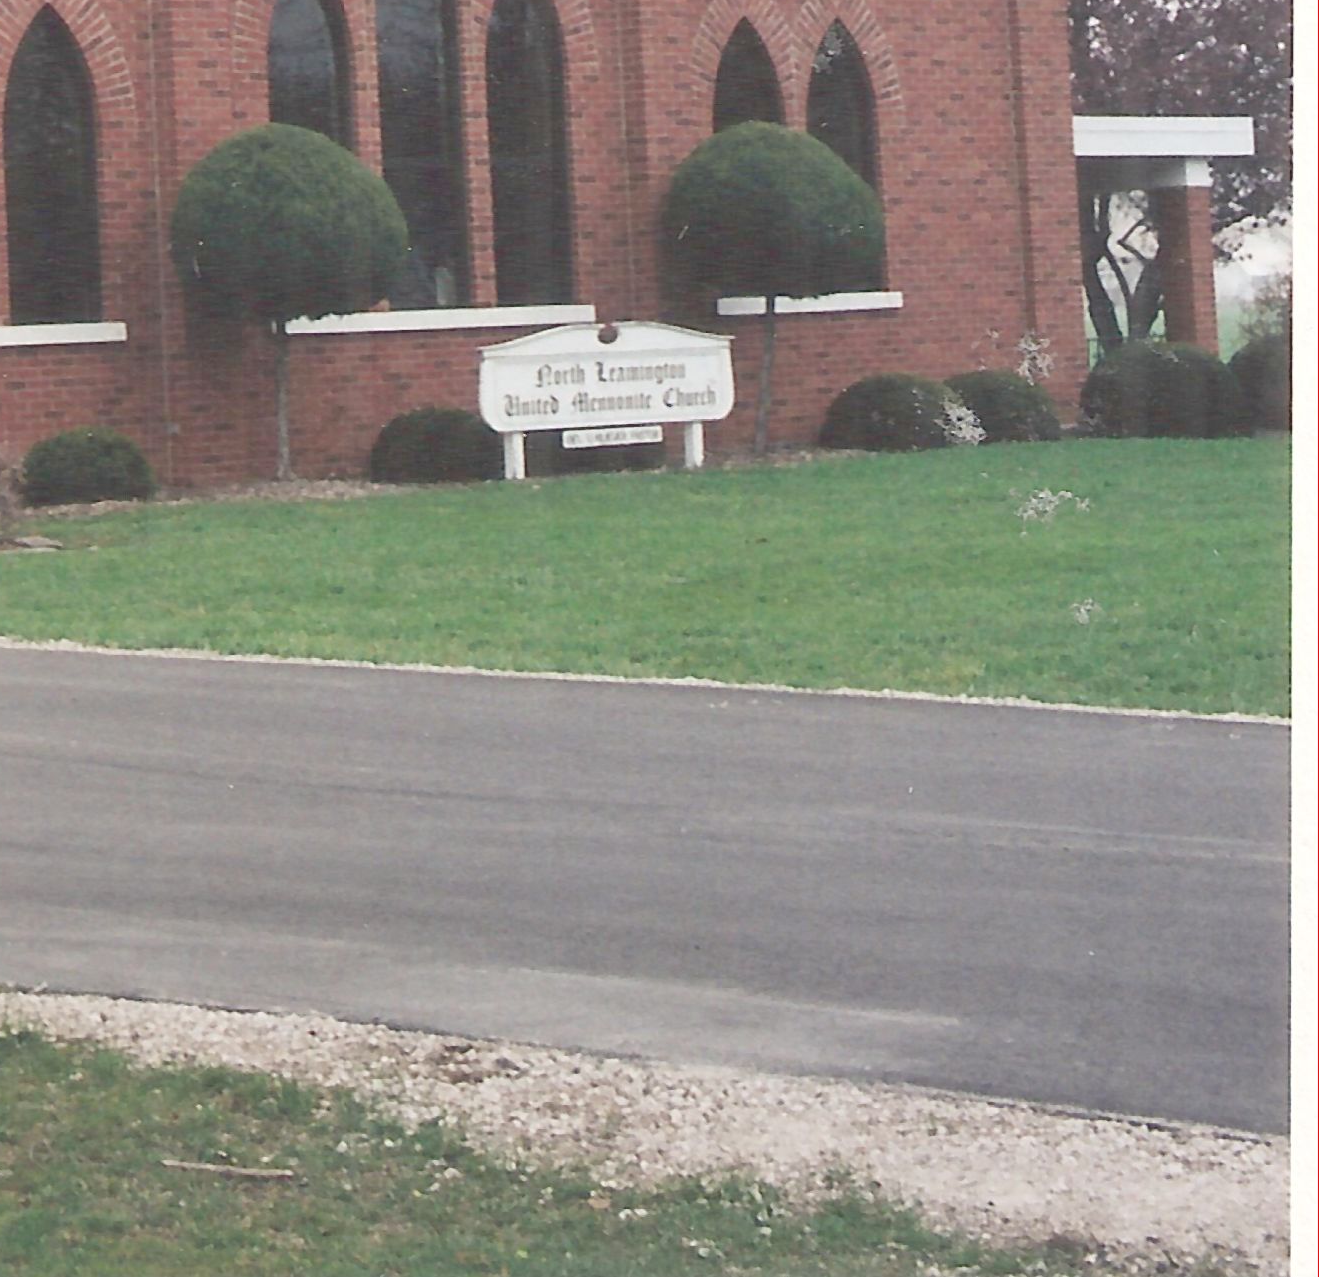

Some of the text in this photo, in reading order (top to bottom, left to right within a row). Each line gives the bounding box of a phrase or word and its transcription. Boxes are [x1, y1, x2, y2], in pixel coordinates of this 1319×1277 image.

[536, 362, 686, 387] North Leamington
[504, 384, 716, 417] United Mennonite Church
